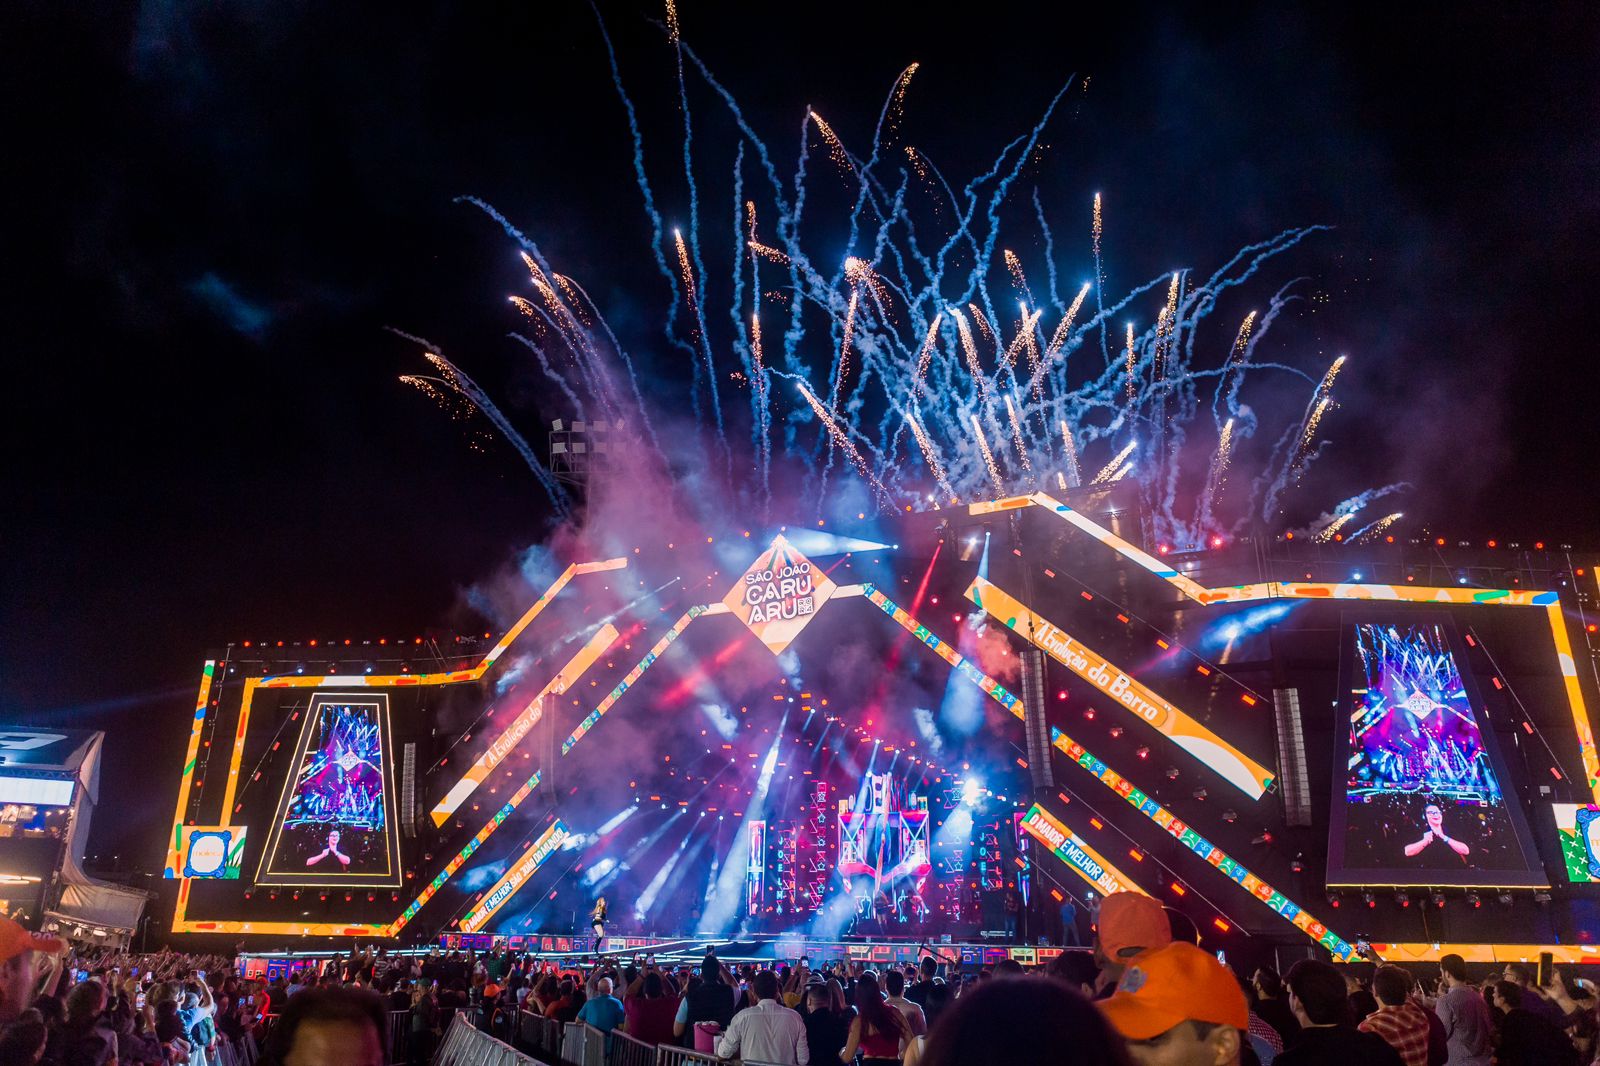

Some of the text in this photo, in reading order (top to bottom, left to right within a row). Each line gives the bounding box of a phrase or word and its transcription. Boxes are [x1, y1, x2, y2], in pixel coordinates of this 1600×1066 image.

[746, 563, 809, 584] SÃO JOÃO
[746, 575, 812, 605] CARU
[748, 598, 798, 625] ARU
[1034, 619, 1158, 720] A Evolução do Barro
[485, 706, 542, 765] A Evolução do
[1035, 816, 1065, 848] MAIOR
[1060, 840, 1071, 852] E
[1065, 844, 1103, 879] MELHOR
[468, 906, 488, 929] MAIOR
[484, 903, 492, 912] E
[488, 882, 513, 910] MELHOR
[510, 872, 523, 889] SÃO
[520, 858, 536, 876] JOÃO
[533, 850, 543, 865] DO
